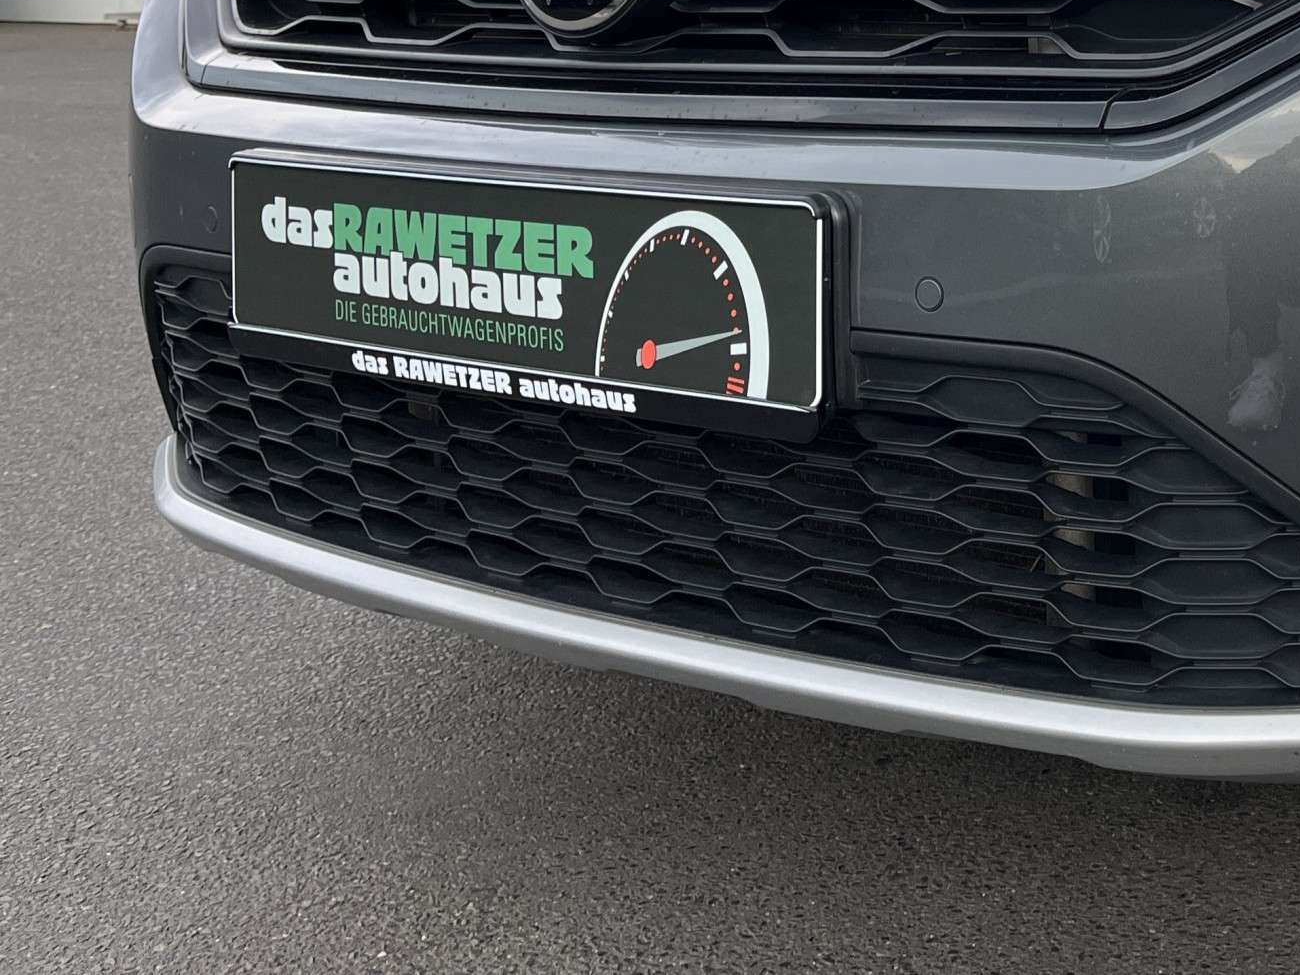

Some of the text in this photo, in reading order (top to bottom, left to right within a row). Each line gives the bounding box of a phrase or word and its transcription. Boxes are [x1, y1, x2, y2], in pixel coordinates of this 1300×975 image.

[333, 251, 563, 320] autohaus
[335, 299, 564, 352] DIE GEBRAUCHTWAGENPROFIS
[352, 350, 636, 413] das RAWETZER autohaus
